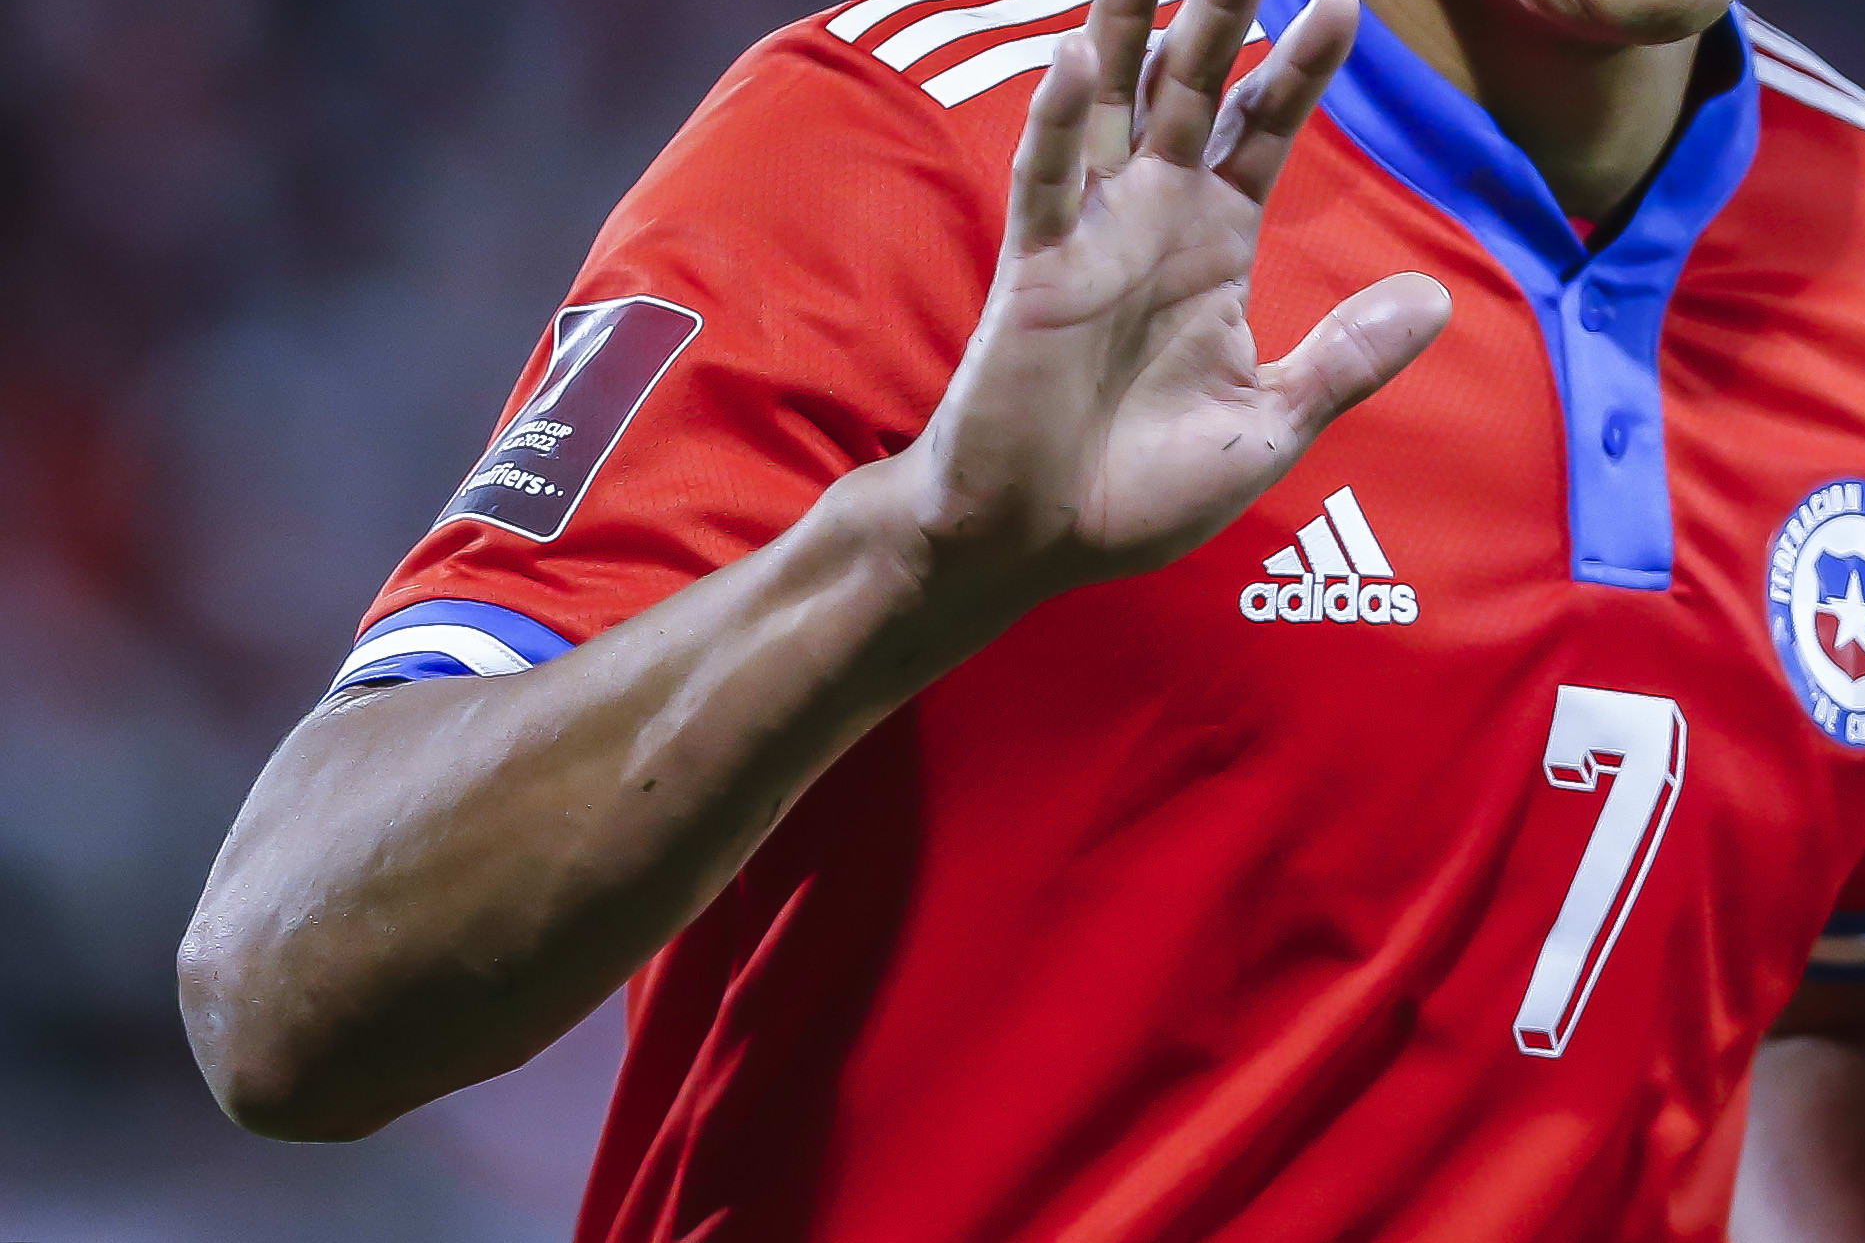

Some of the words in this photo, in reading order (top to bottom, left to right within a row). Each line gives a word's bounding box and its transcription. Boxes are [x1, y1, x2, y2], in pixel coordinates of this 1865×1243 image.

[545, 421, 573, 438] CUP
[1239, 572, 1420, 625] adidas
[1512, 684, 1688, 1058] 7
